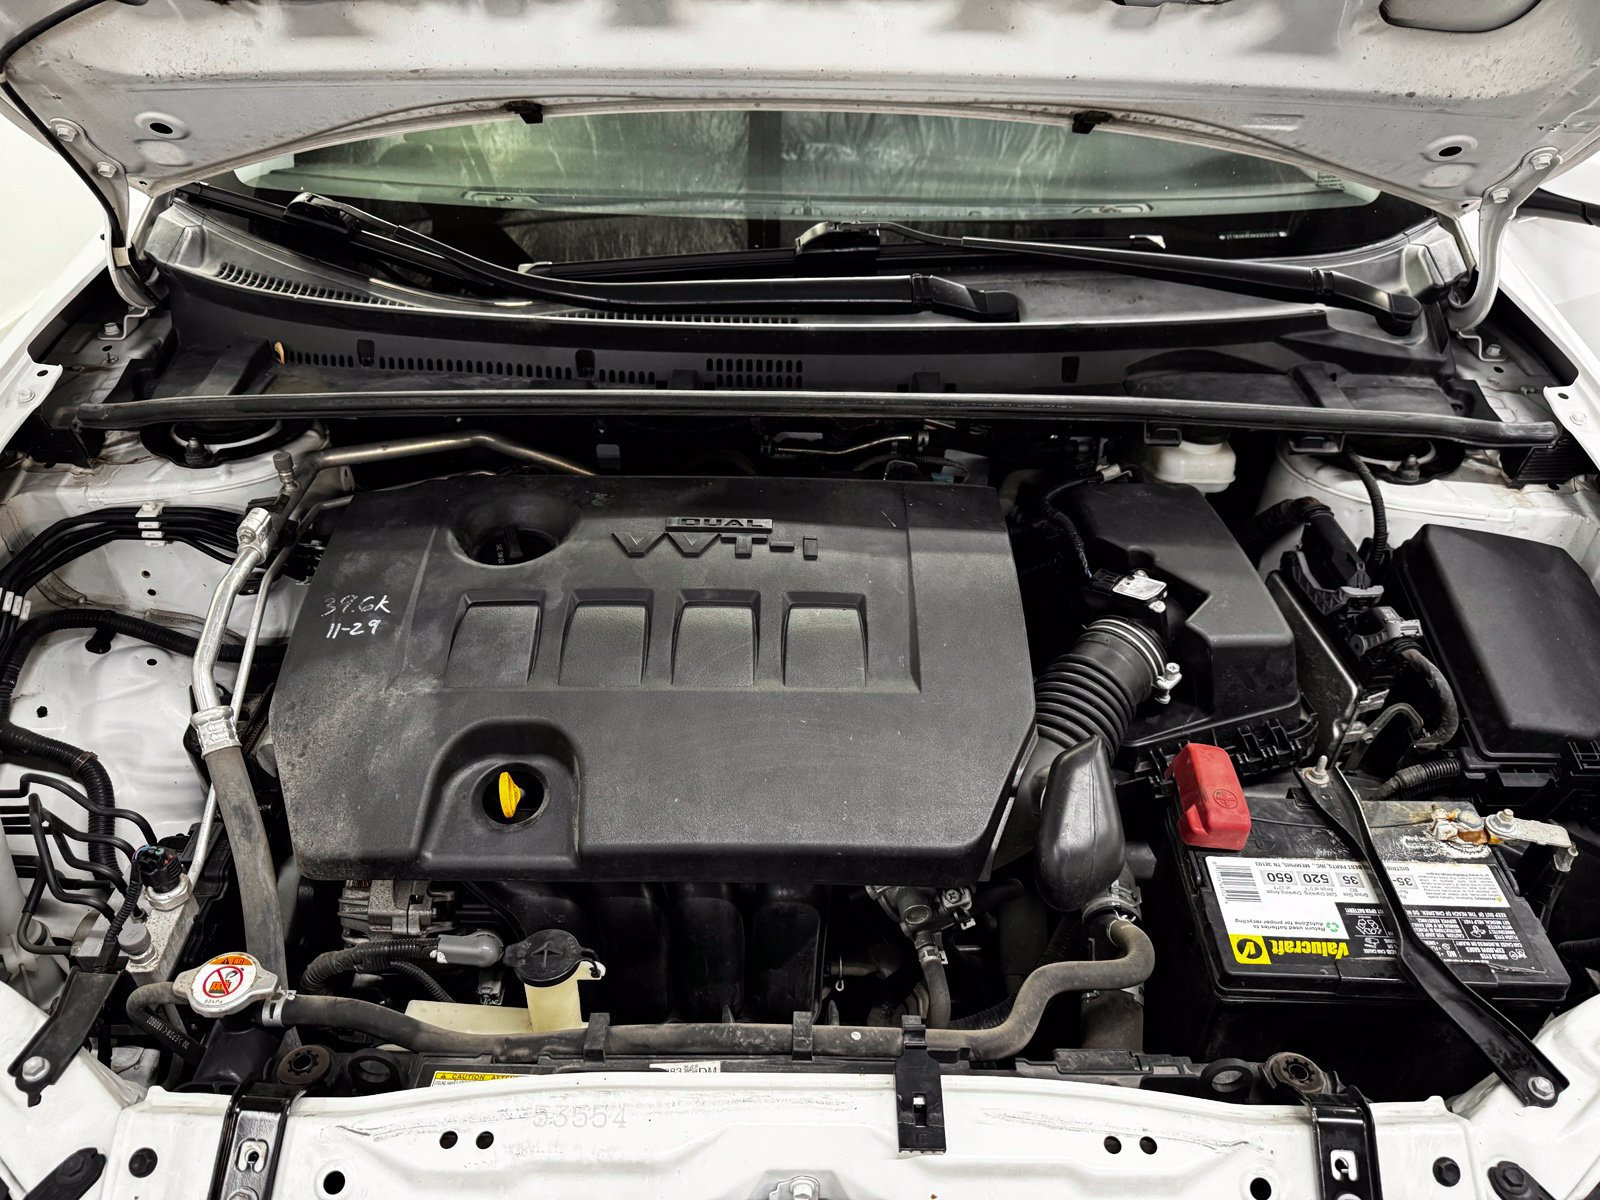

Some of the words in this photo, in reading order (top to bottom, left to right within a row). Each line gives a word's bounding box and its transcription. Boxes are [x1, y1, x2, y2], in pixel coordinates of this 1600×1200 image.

[680, 518, 763, 527] DUAL
[326, 619, 381, 639] 11-29
[1267, 873, 1293, 883] 650
[1303, 874, 1329, 884] 520
[1342, 876, 1359, 885] 35
[1392, 877, 1413, 886] 35-
[1269, 940, 1349, 960] Valucraft
[533, 1103, 626, 1128] 53554
